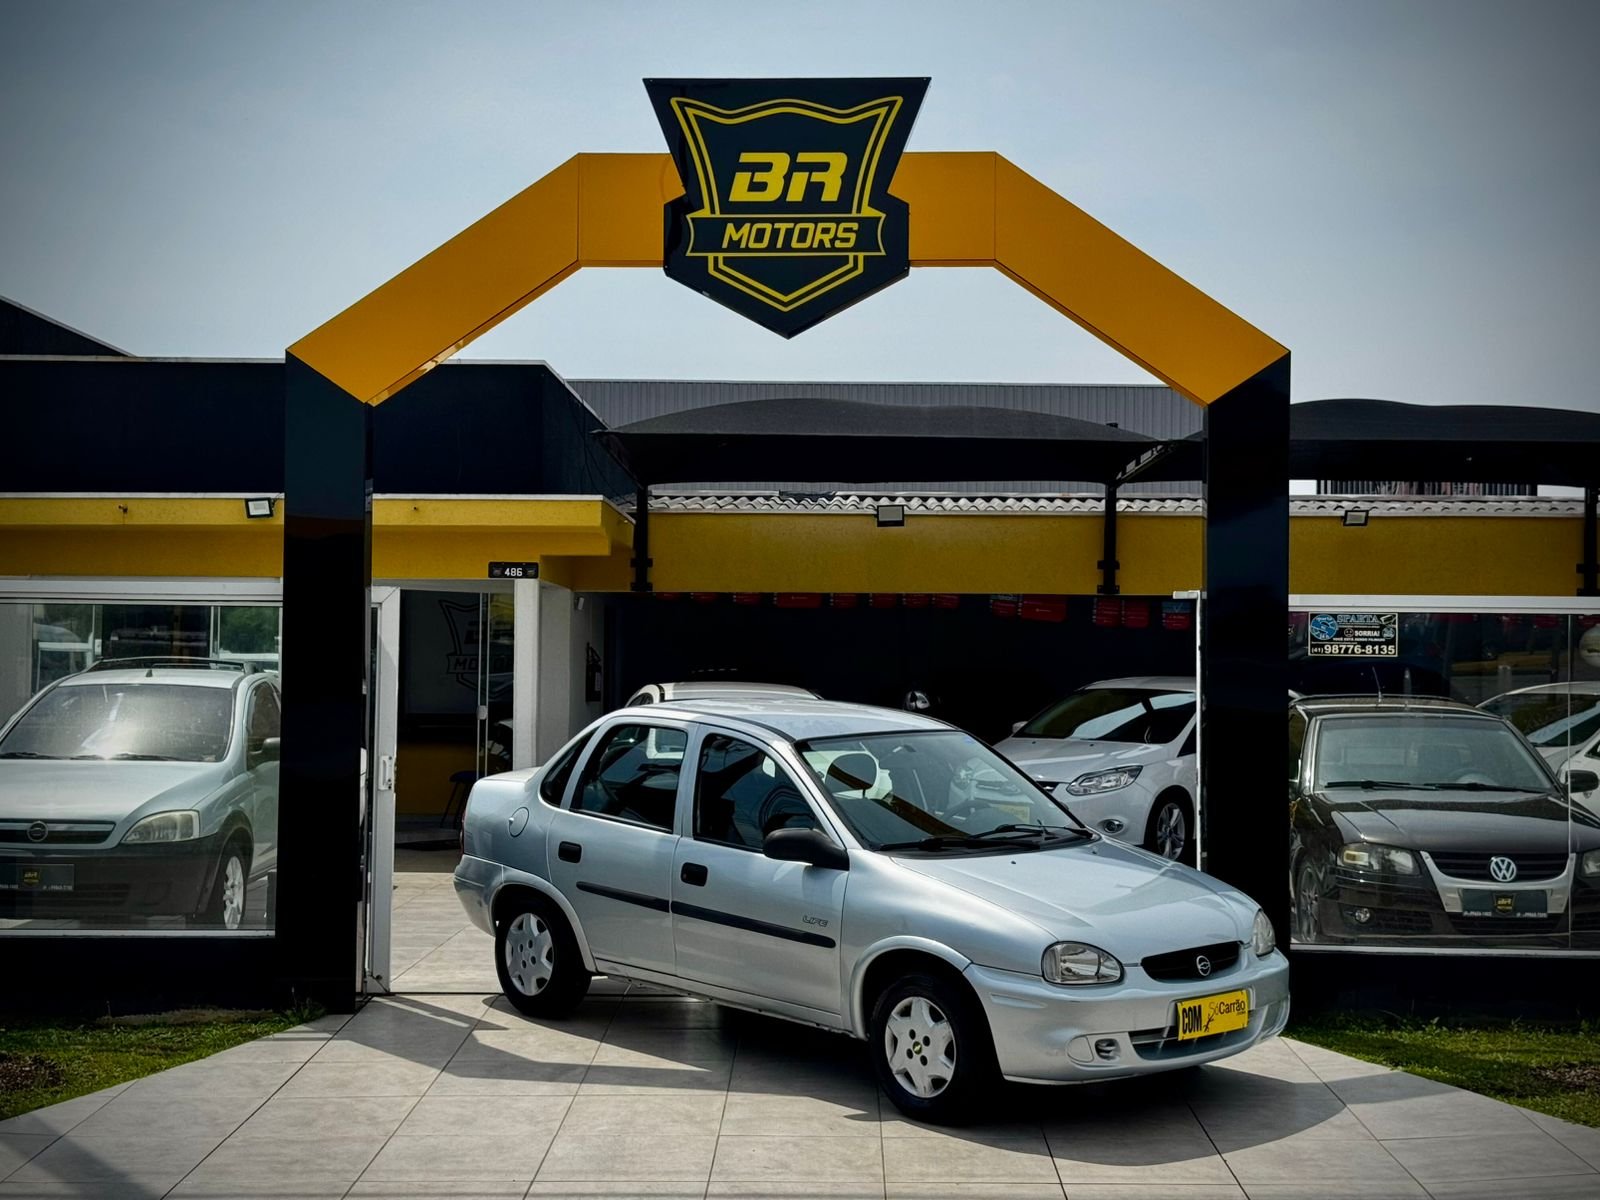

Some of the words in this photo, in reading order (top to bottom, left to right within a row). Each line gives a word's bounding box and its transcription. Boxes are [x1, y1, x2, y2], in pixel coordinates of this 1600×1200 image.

[728, 152, 848, 202] BR
[721, 222, 859, 249] MOTORS
[504, 567, 523, 577] 486
[1324, 644, 1395, 654] 98776-8135
[1181, 1004, 1202, 1034] COM
